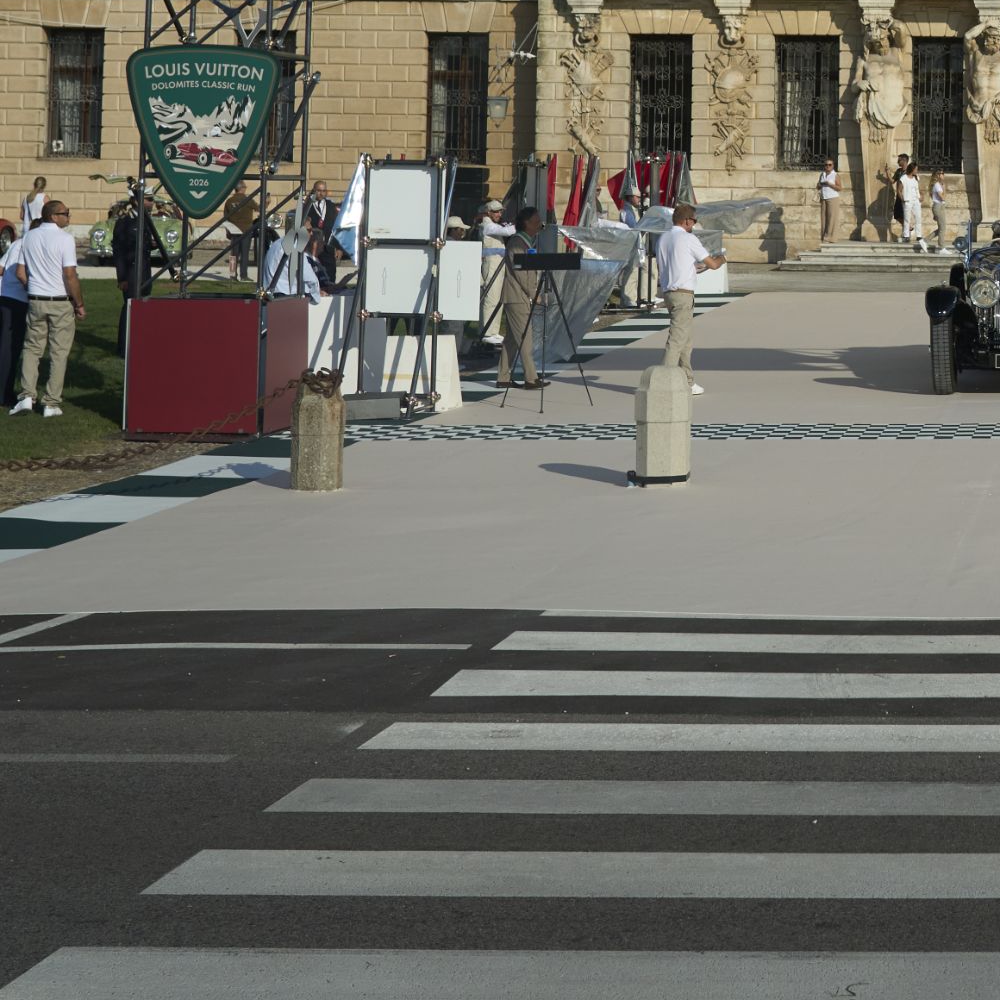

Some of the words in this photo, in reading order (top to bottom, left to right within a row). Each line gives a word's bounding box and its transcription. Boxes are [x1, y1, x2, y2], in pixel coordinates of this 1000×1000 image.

[145, 63, 190, 79] LOUIS
[194, 63, 263, 81] VUITTON
[152, 80, 199, 90] DOLOMITES
[202, 81, 235, 90] CLASSIC
[237, 83, 255, 92] RUN
